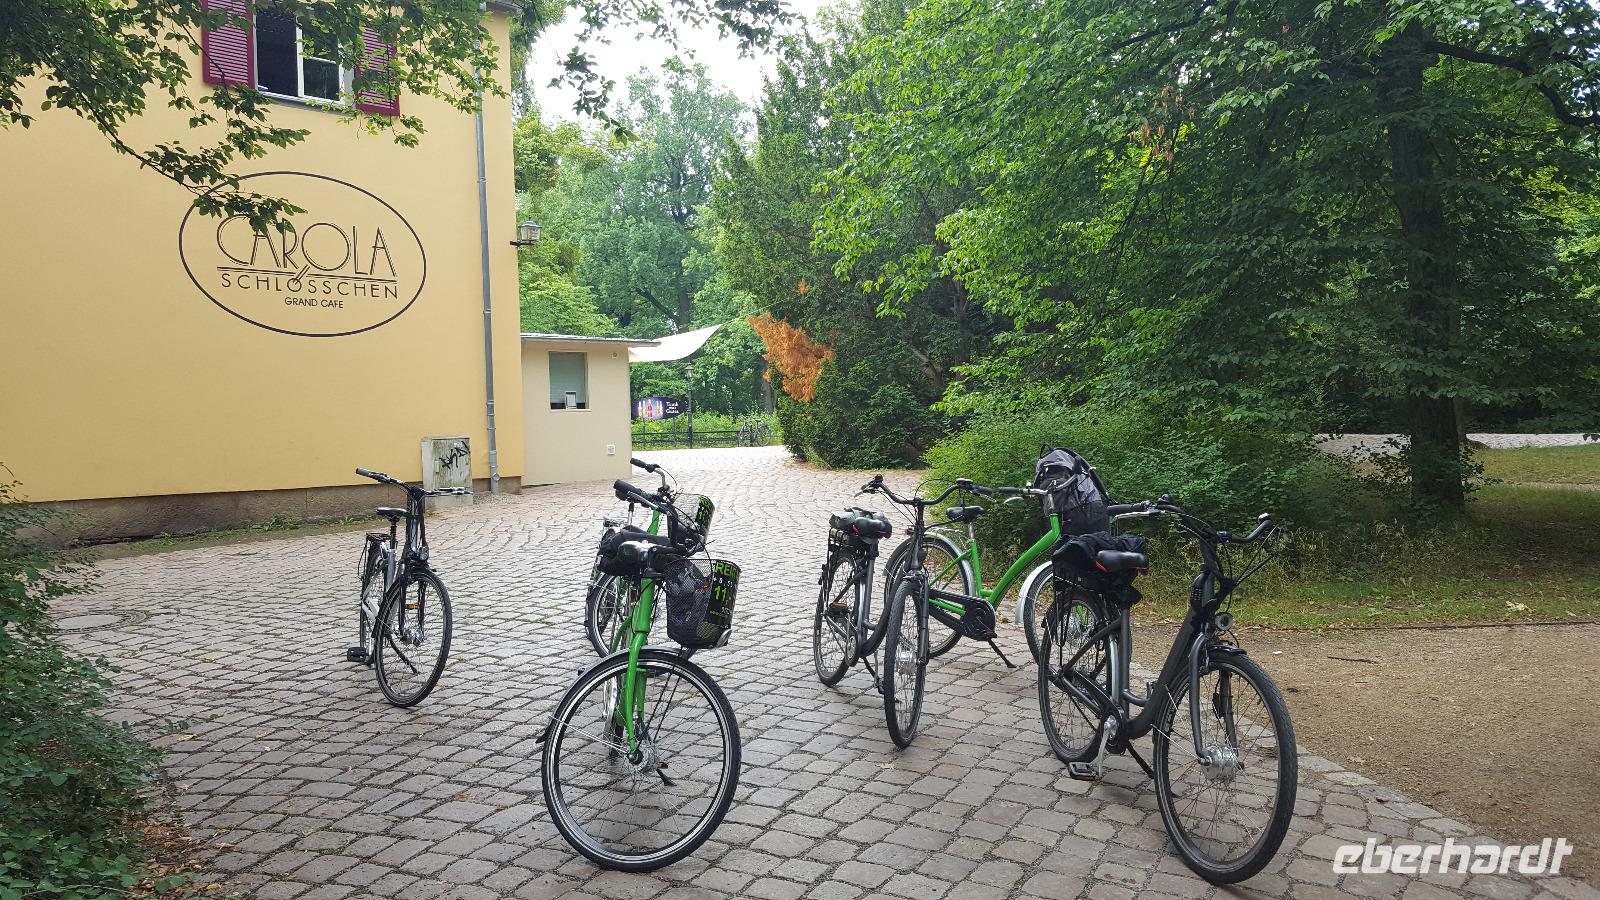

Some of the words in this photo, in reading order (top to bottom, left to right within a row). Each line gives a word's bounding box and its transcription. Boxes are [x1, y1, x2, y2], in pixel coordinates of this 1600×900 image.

[216, 214, 398, 277] CAROLA
[284, 297, 318, 308] GRAND
[320, 299, 344, 309] CAFE
